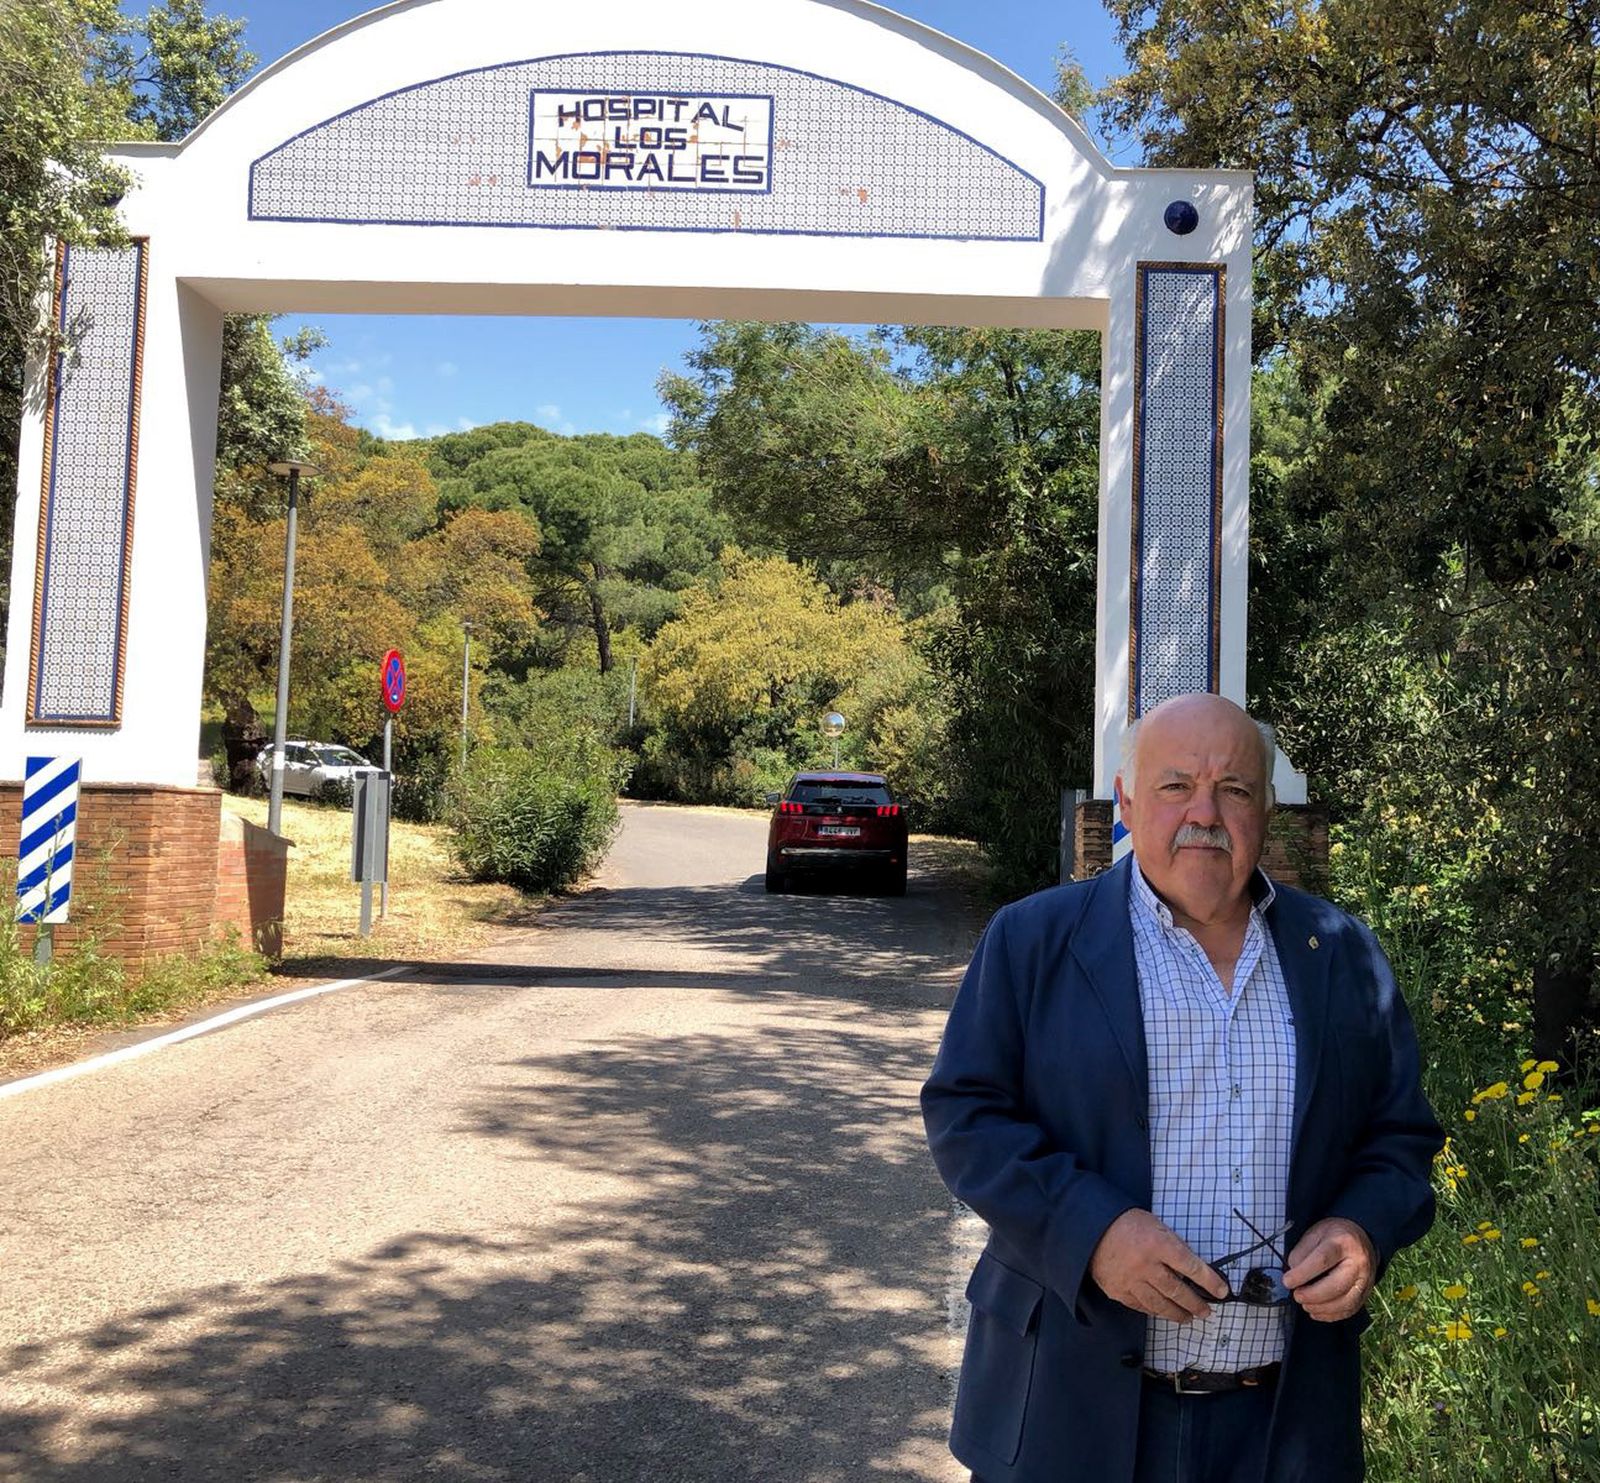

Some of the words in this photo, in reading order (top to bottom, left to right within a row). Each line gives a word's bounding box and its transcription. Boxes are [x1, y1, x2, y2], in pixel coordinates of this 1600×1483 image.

[558, 98, 744, 132] HOSPITAL
[614, 126, 687, 150] LOS
[536, 151, 764, 184] MORALES
